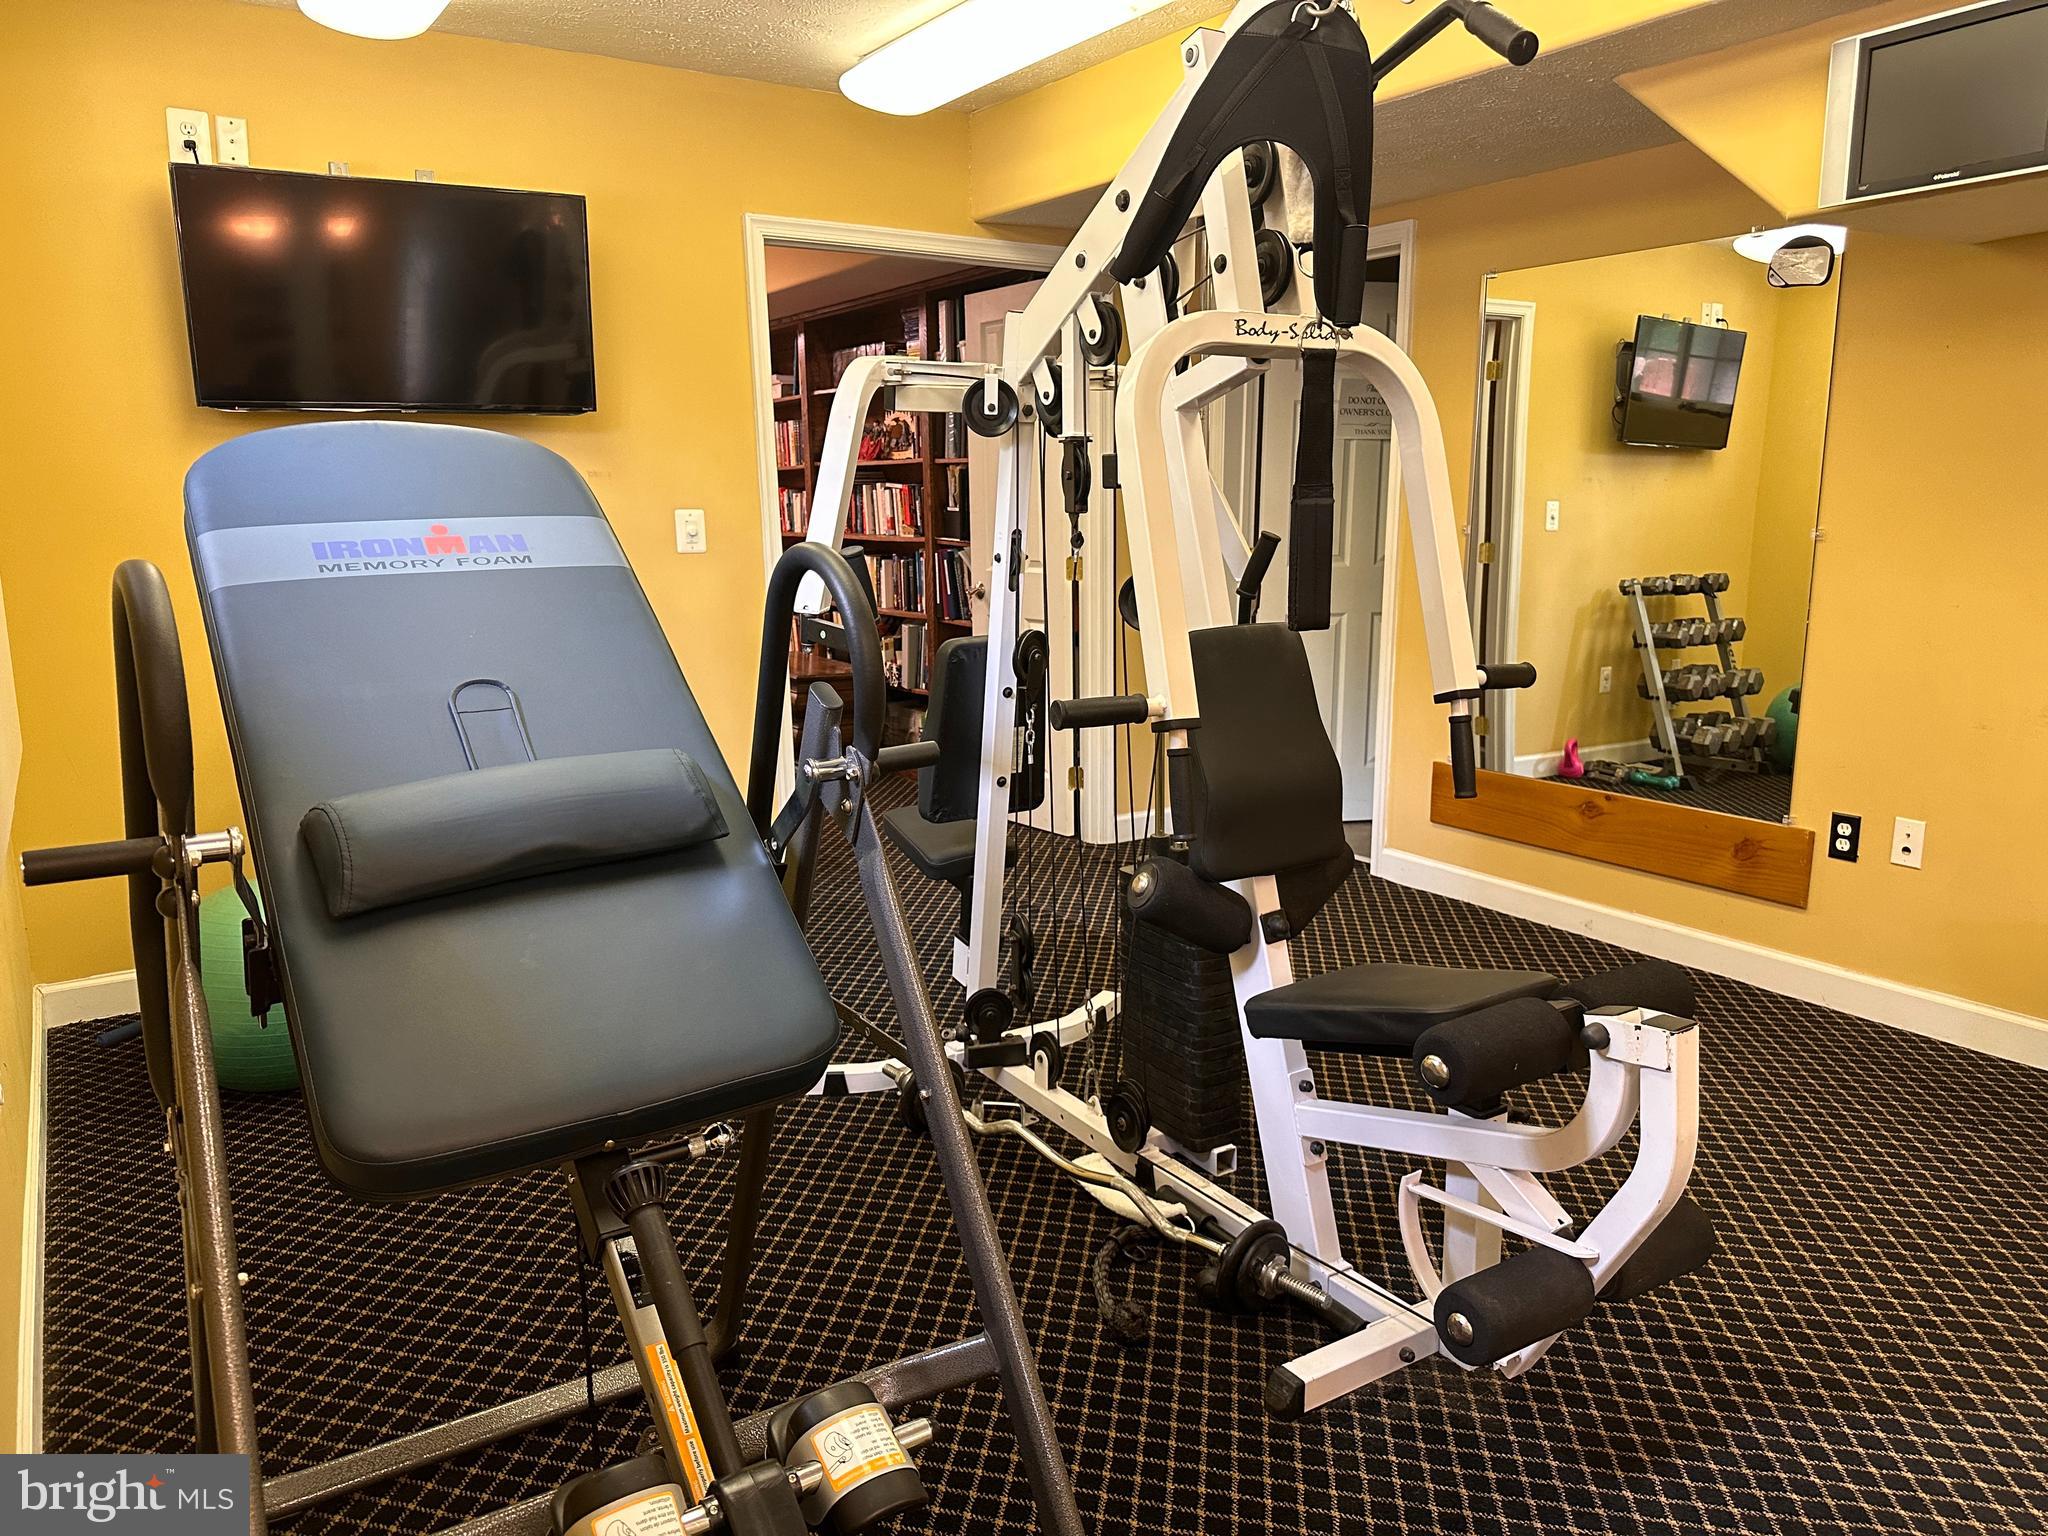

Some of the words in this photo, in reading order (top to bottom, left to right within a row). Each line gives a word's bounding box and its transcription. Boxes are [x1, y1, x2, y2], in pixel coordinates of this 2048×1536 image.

[1347, 396, 1359, 405] DO
[1360, 396, 1376, 405] NOT
[311, 523, 529, 560] IRONMAN
[318, 558, 445, 573] MEMORY
[456, 554, 533, 567] FOAM
